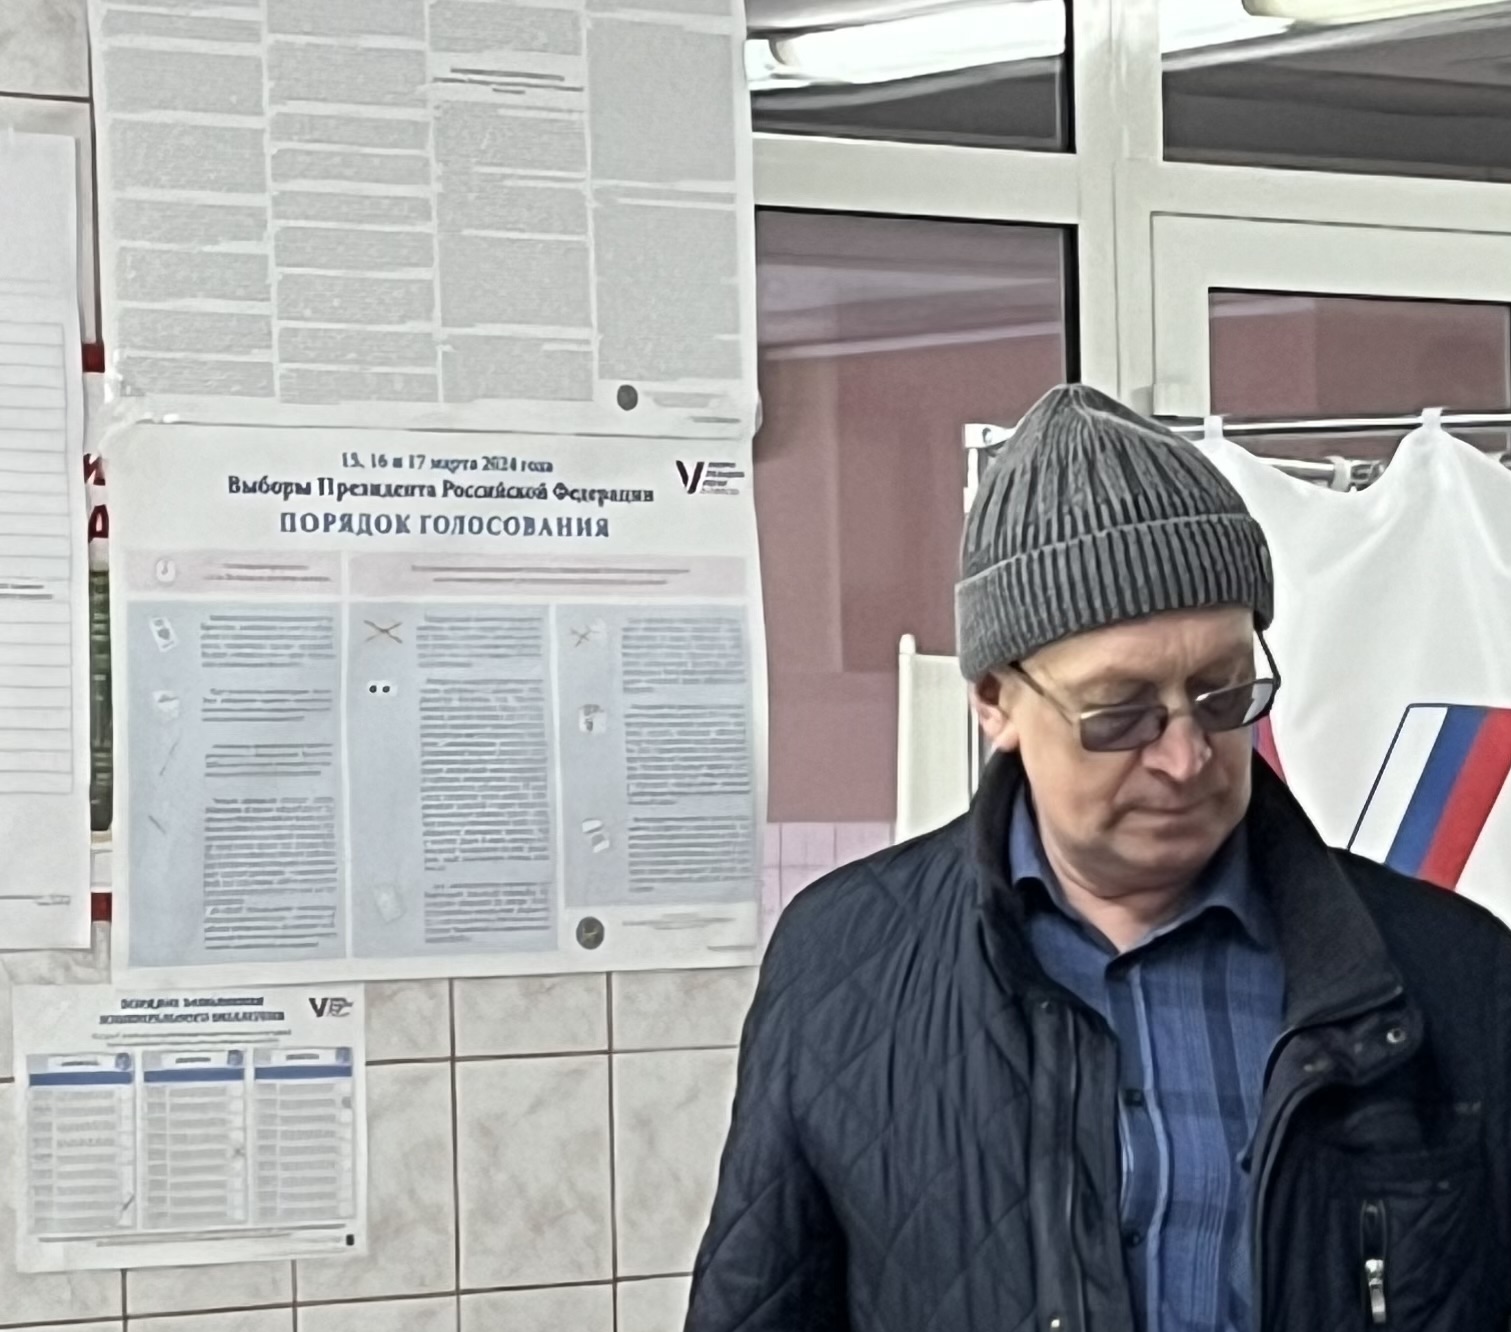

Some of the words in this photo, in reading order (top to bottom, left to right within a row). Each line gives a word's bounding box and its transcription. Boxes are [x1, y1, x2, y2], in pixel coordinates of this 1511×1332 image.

[371, 453, 388, 468] 16
[409, 454, 426, 469] 17
[228, 475, 311, 501] Выборы
[317, 477, 437, 502] Президента
[442, 479, 549, 500] Российской
[552, 482, 655, 507] Федерации
[280, 512, 411, 536] ПОРЯДОК
[419, 514, 610, 538] ГОЛОСОВАНИЯ
